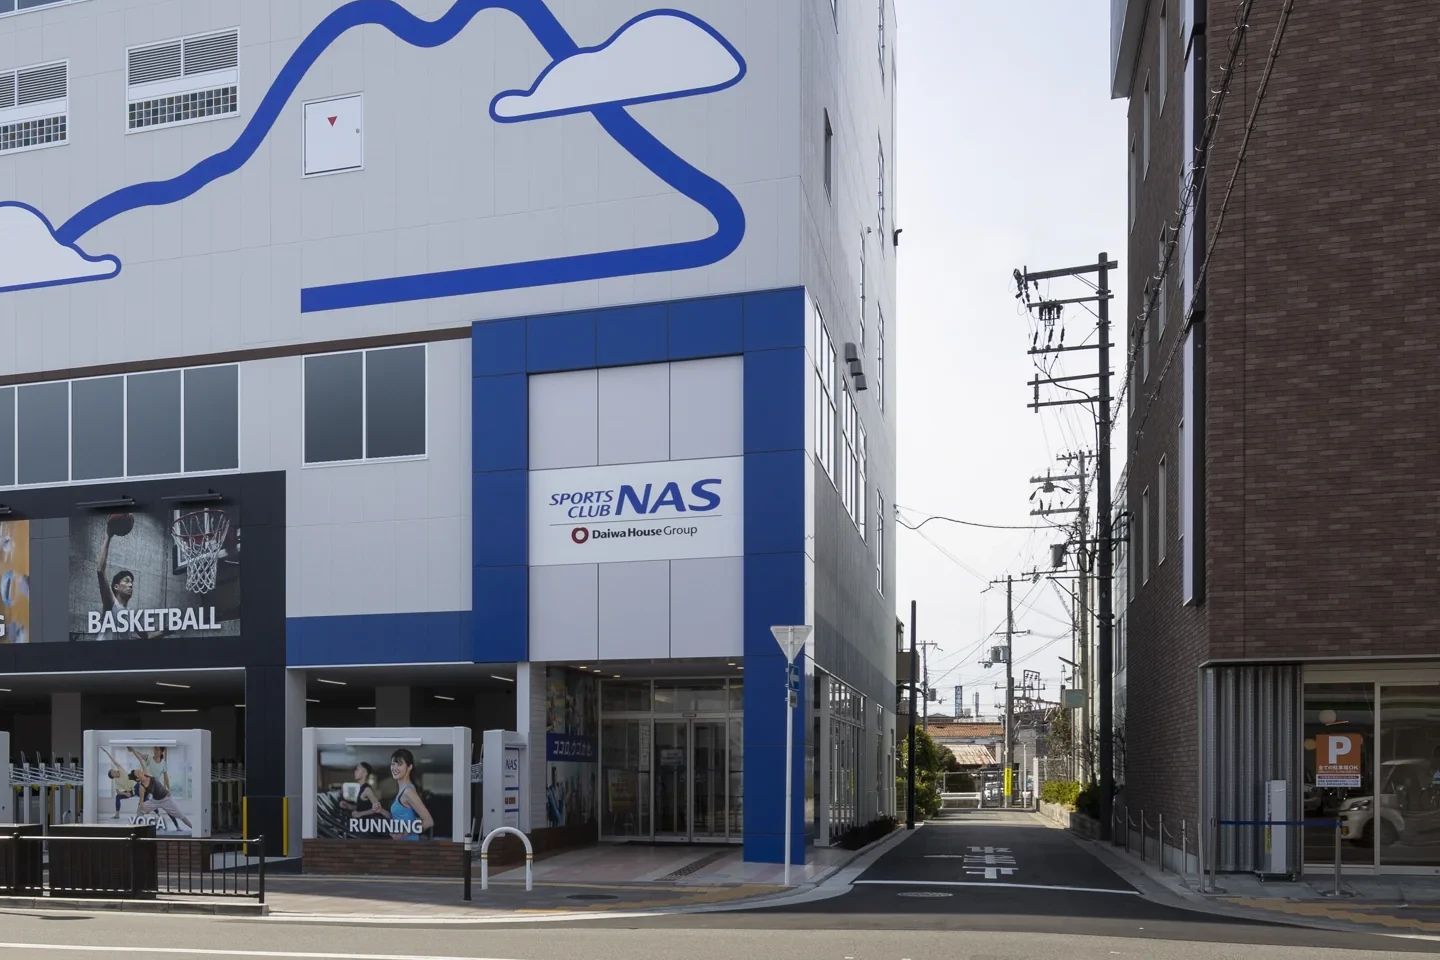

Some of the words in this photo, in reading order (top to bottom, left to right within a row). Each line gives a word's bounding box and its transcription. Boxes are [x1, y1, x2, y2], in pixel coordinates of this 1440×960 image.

[548, 490, 614, 506] SPORTS
[615, 478, 722, 516] NAS
[567, 505, 611, 518] CLUB
[592, 529, 626, 539] Daiwa
[627, 527, 662, 538] House
[663, 525, 698, 537] Group
[87, 606, 222, 634] BASKETBALL
[1328, 735, 1352, 764] P
[505, 759, 517, 771] NAS
[128, 815, 166, 830] YOGA
[349, 818, 423, 834] RUNNING
